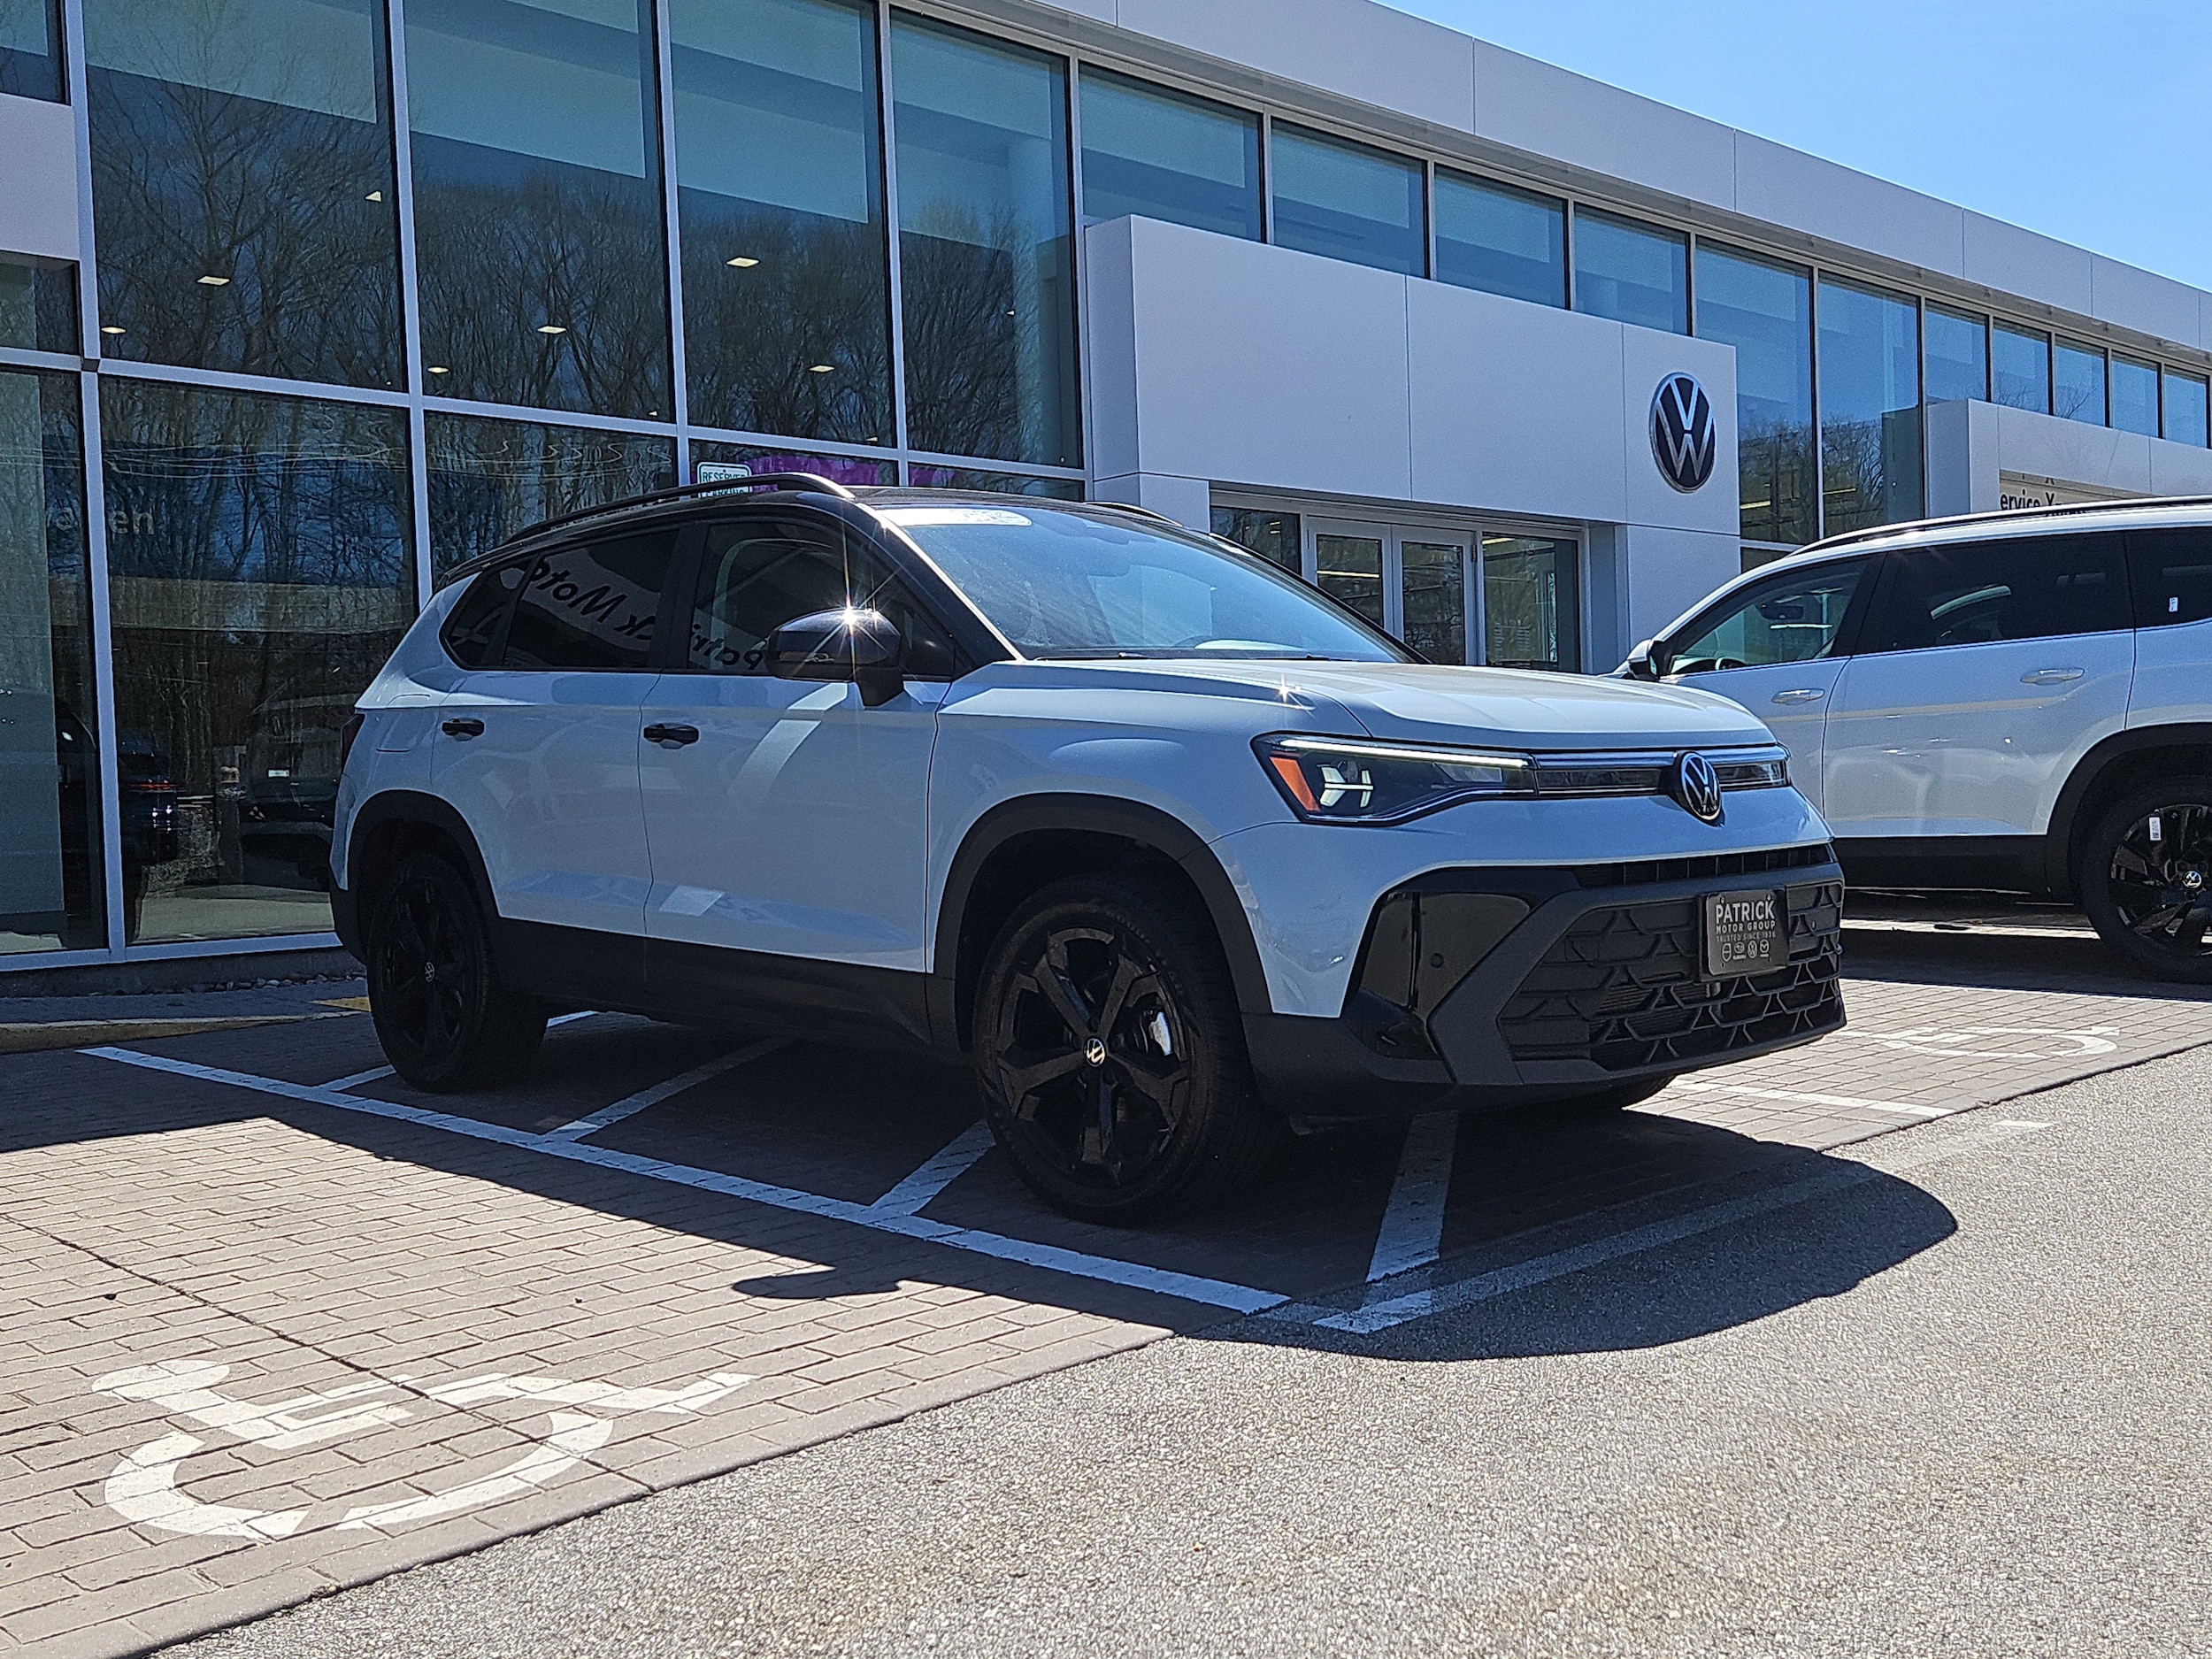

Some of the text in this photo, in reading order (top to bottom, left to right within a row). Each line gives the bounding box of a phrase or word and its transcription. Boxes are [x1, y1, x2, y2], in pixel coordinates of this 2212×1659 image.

[1716, 900, 1775, 925] PATRICK
[1716, 920, 1776, 934] MOTOR GROUP
